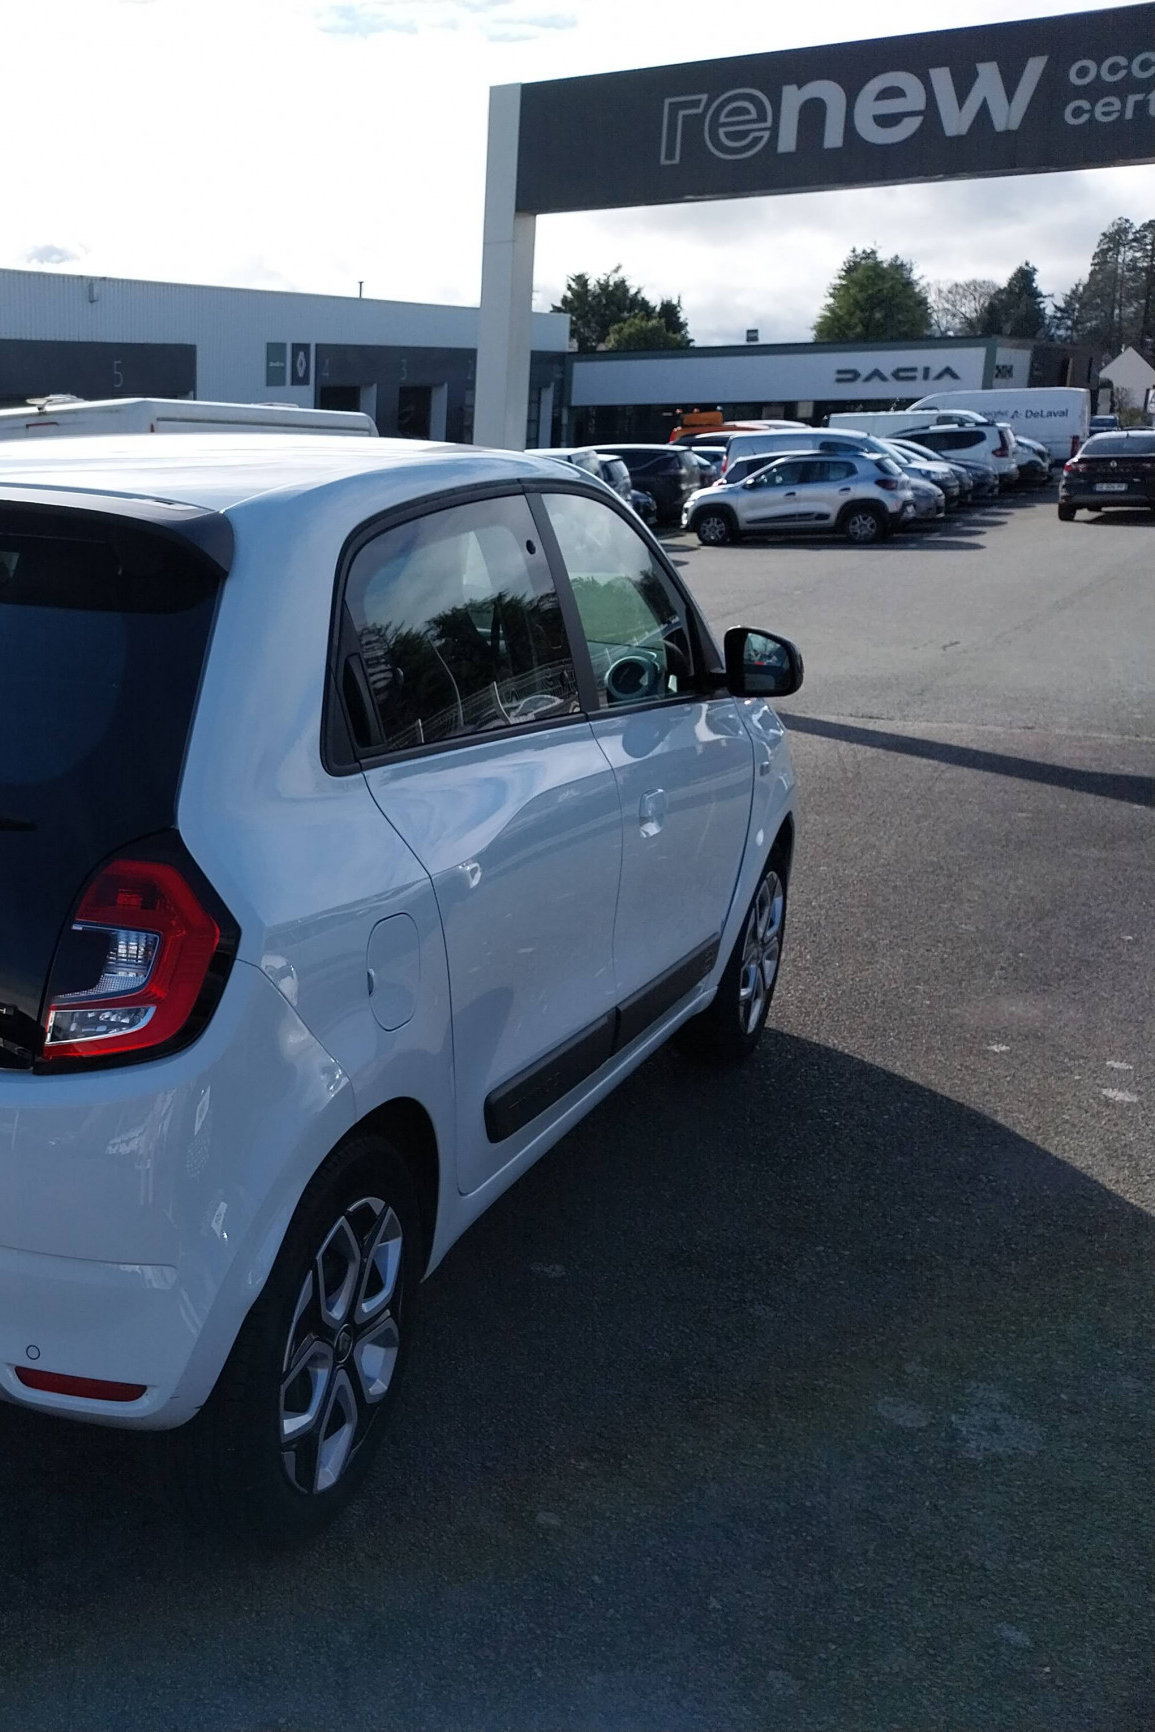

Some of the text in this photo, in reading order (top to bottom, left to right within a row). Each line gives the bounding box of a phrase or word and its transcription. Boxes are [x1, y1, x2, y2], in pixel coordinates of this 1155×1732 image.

[659, 55, 1049, 165] renew
[113, 360, 124, 388] 5
[835, 366, 961, 383] DACIA
[1024, 408, 1069, 420] DeLaval
